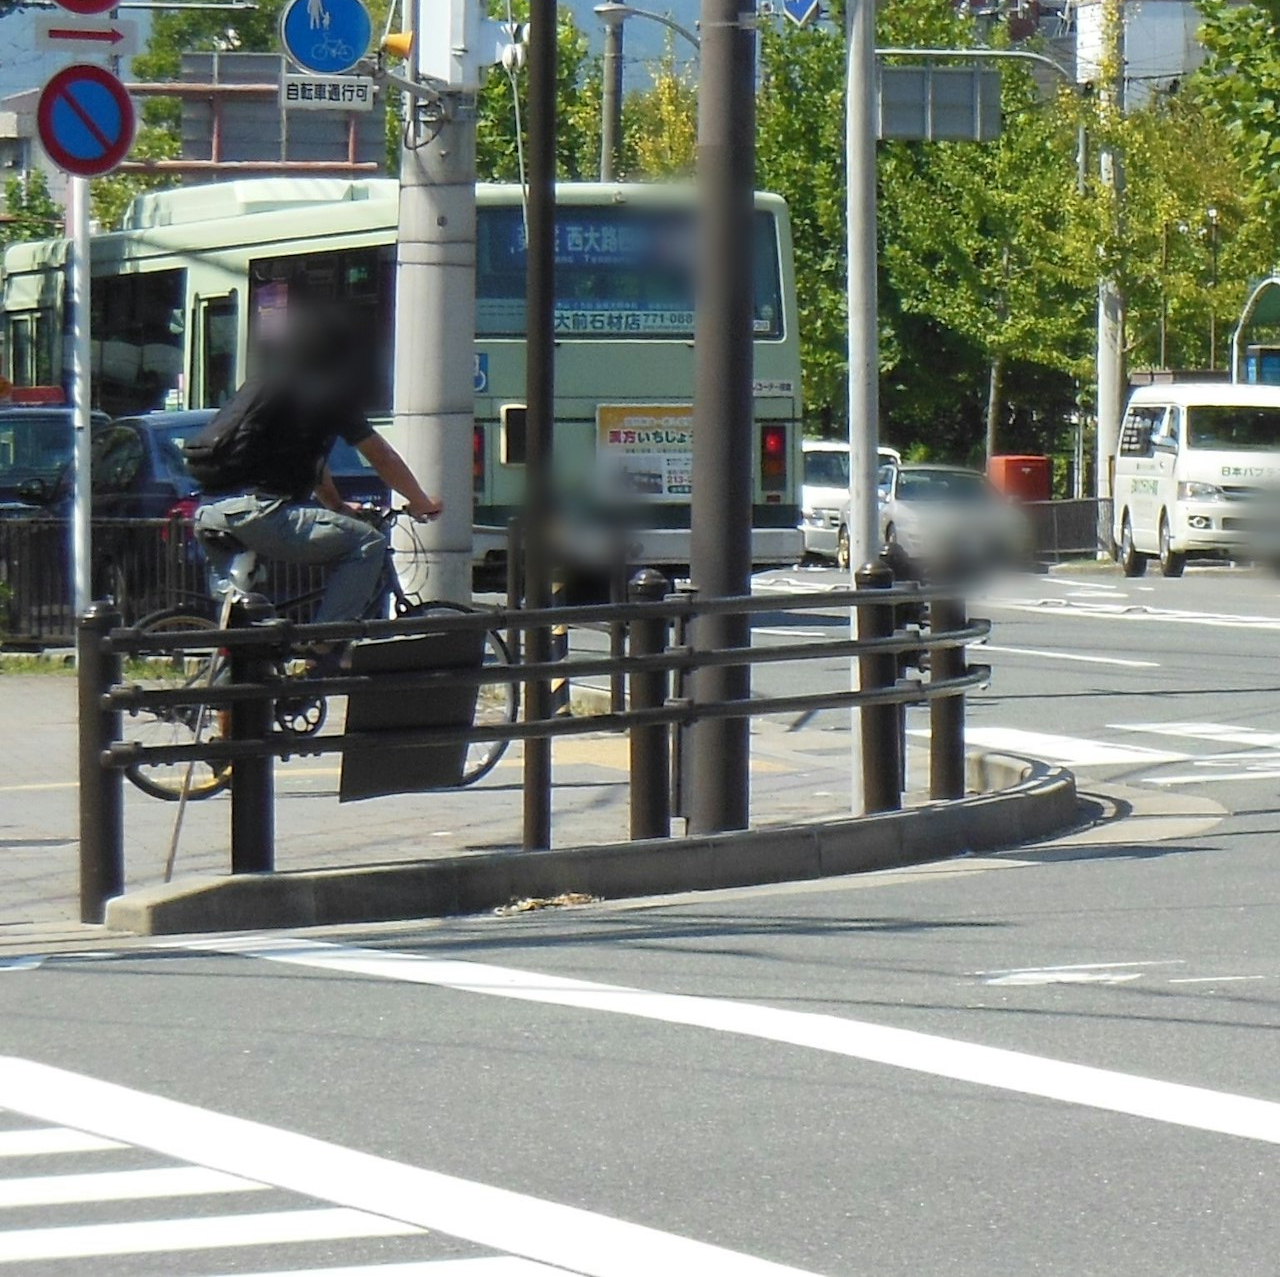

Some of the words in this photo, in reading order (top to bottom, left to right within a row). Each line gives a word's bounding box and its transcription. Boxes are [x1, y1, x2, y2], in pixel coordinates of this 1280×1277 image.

[287, 82, 368, 102] 自転車通行可
